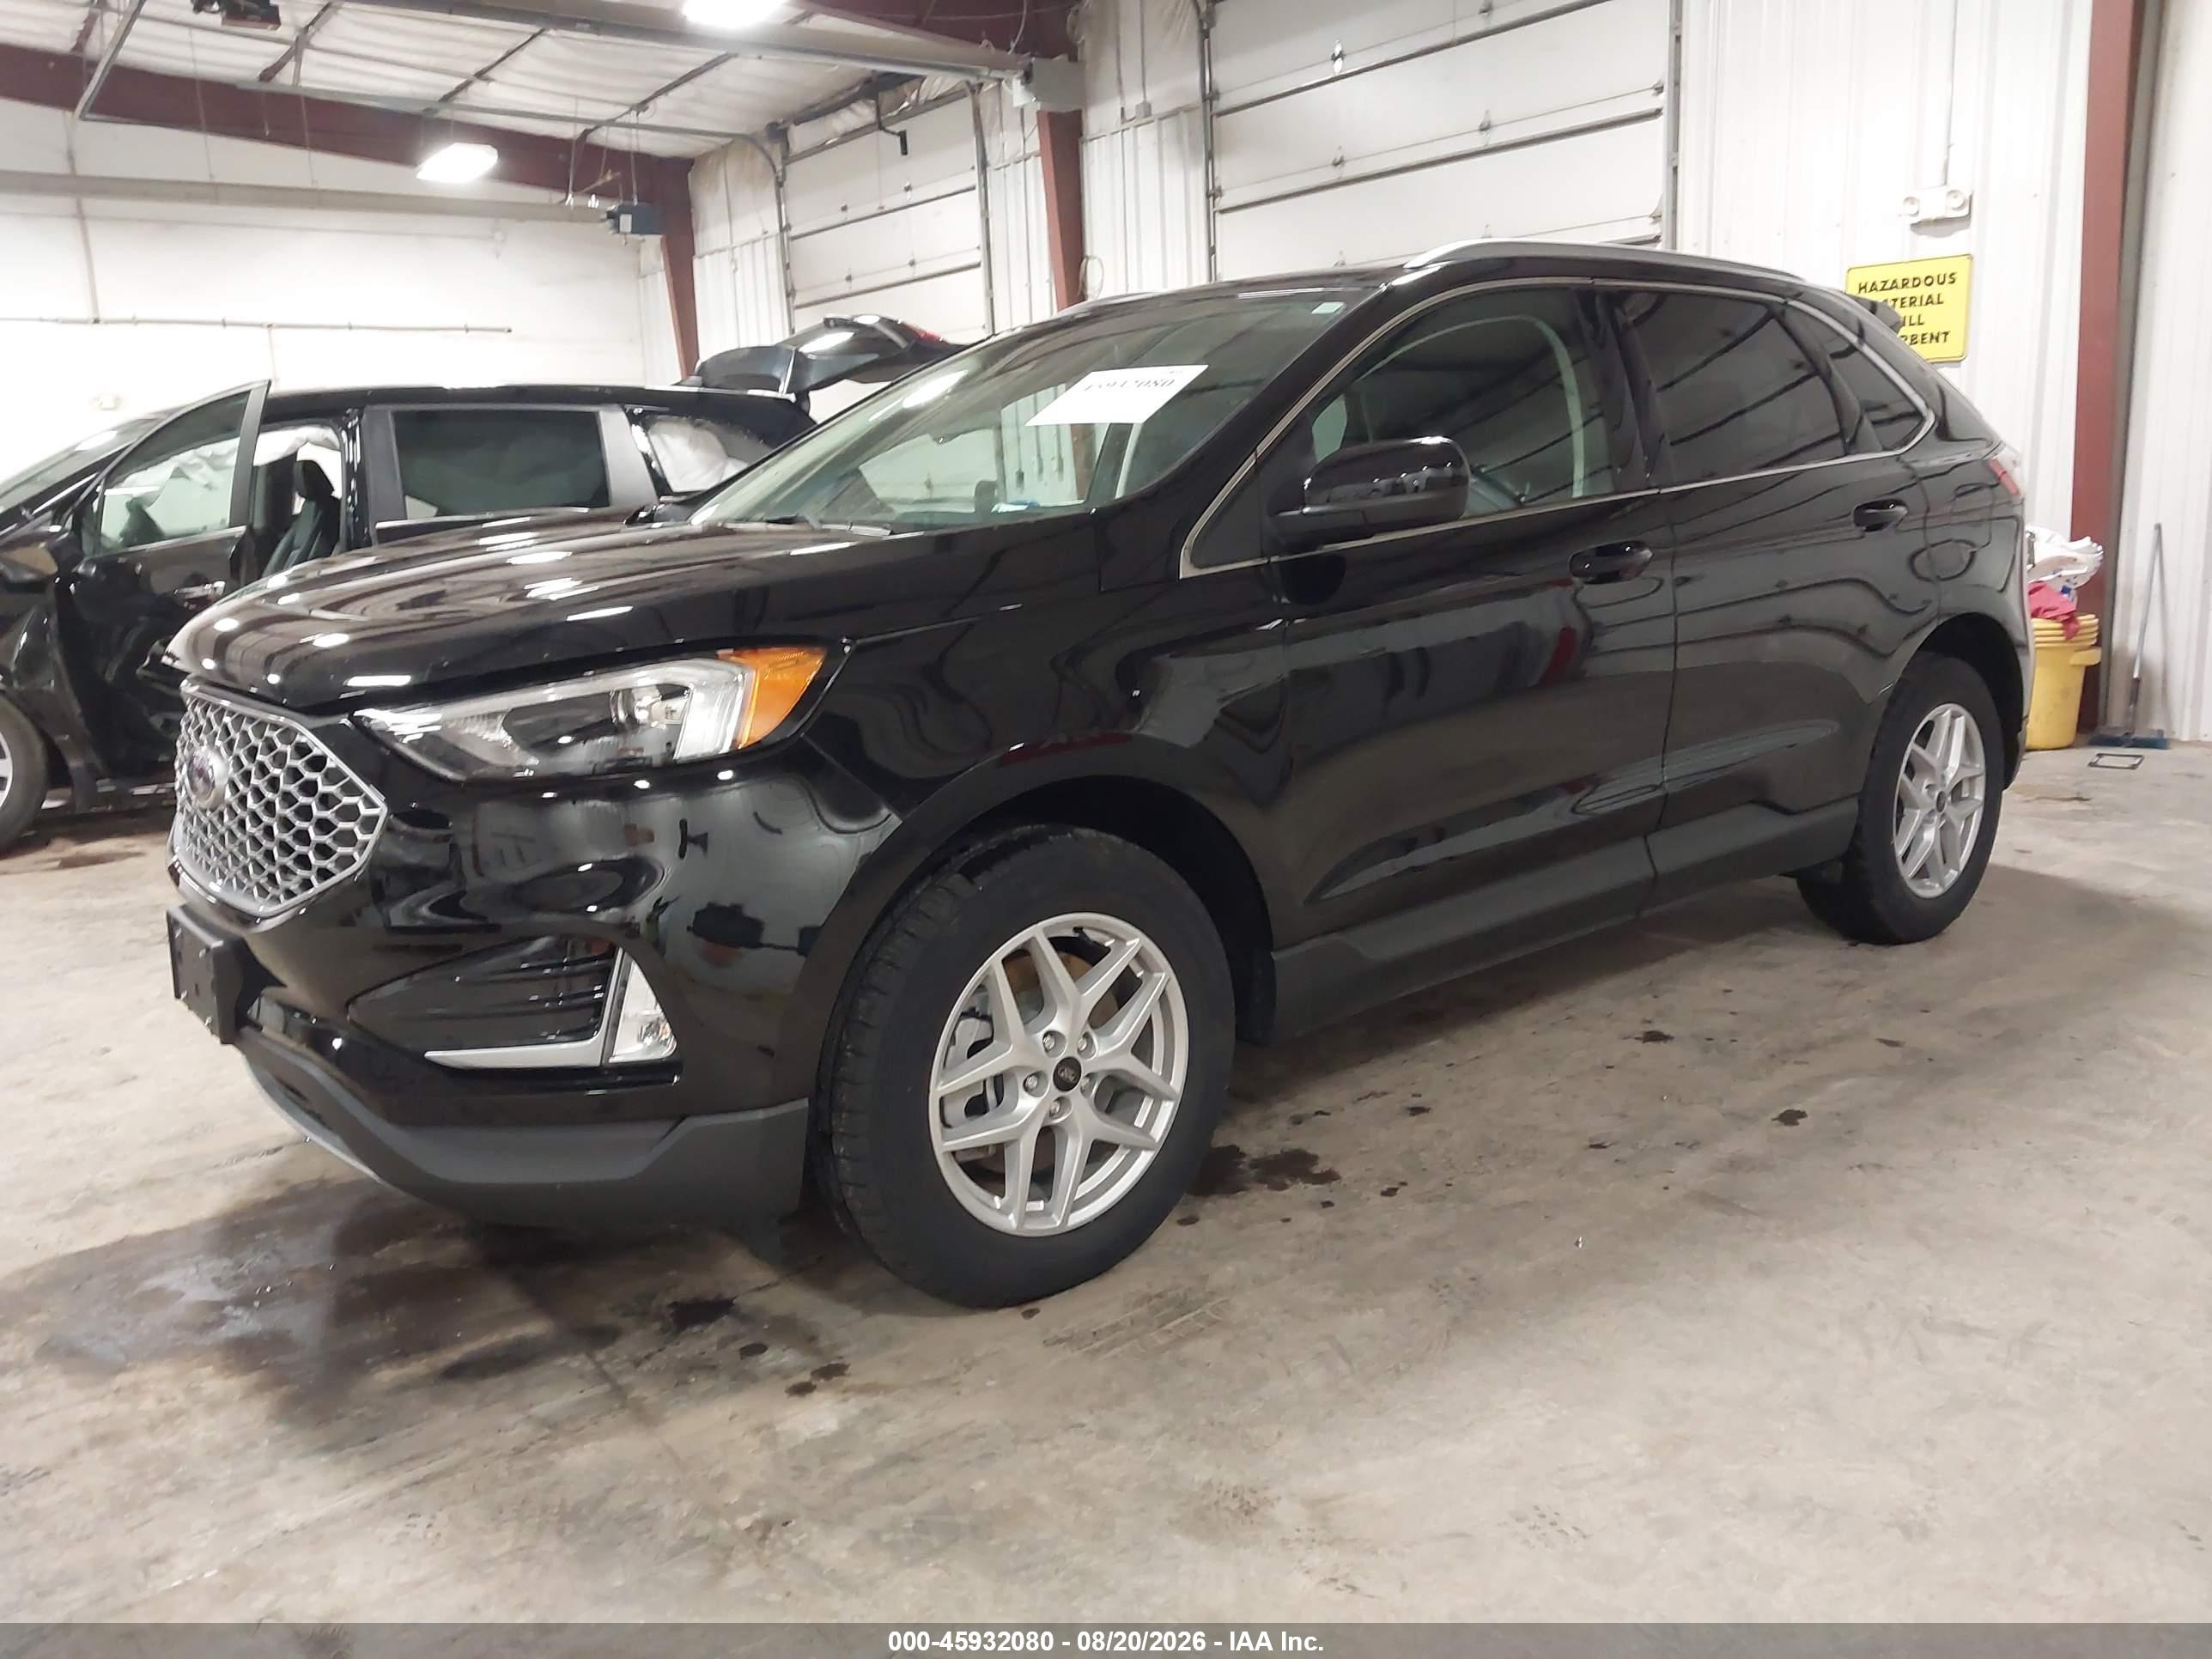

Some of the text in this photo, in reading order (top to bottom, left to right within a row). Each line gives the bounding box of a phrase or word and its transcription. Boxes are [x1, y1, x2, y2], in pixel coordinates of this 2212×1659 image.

[1857, 271, 1958, 294] HAZARDOUS
[1881, 293, 1945, 309] TERIAL
[1902, 313, 1925, 327] ILL
